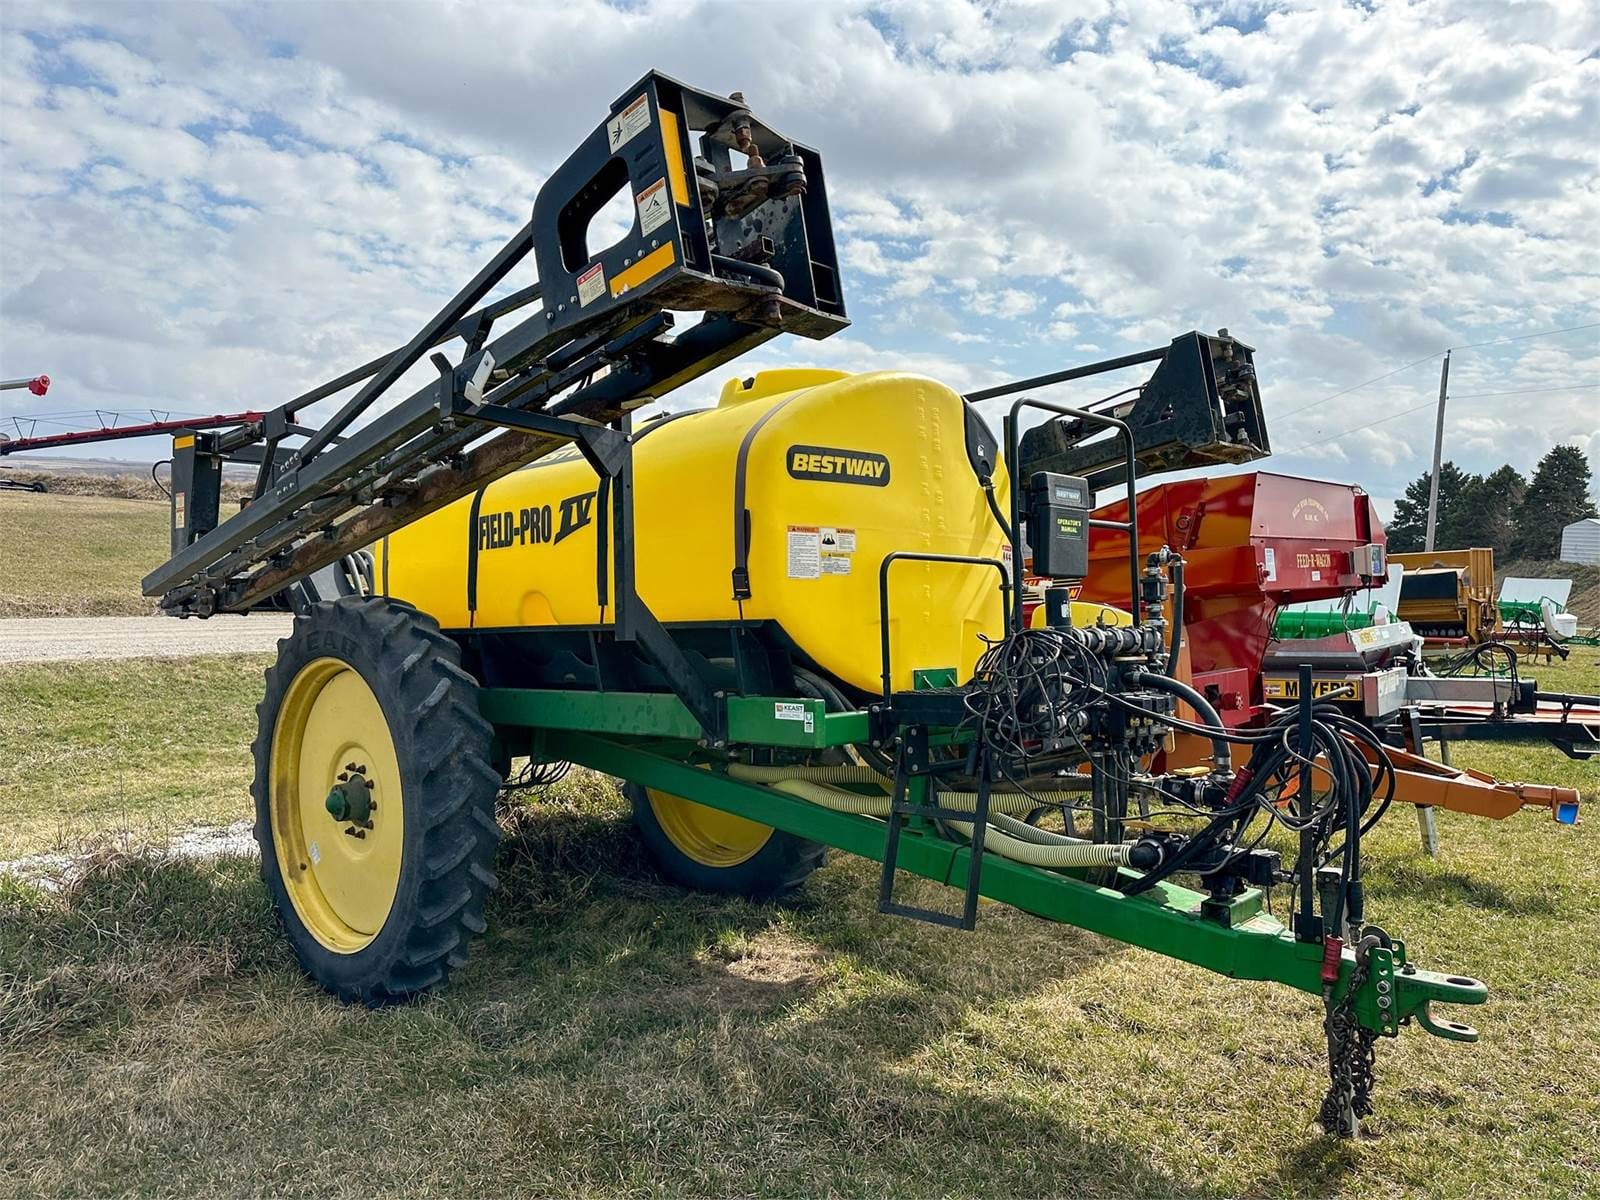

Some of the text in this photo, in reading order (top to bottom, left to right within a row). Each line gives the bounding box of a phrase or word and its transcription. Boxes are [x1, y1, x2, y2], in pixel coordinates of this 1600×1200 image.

[792, 453, 886, 479] BESTWAY
[479, 490, 597, 551] FIELD-PRO IV
[1285, 681, 1355, 698] MYER'S
